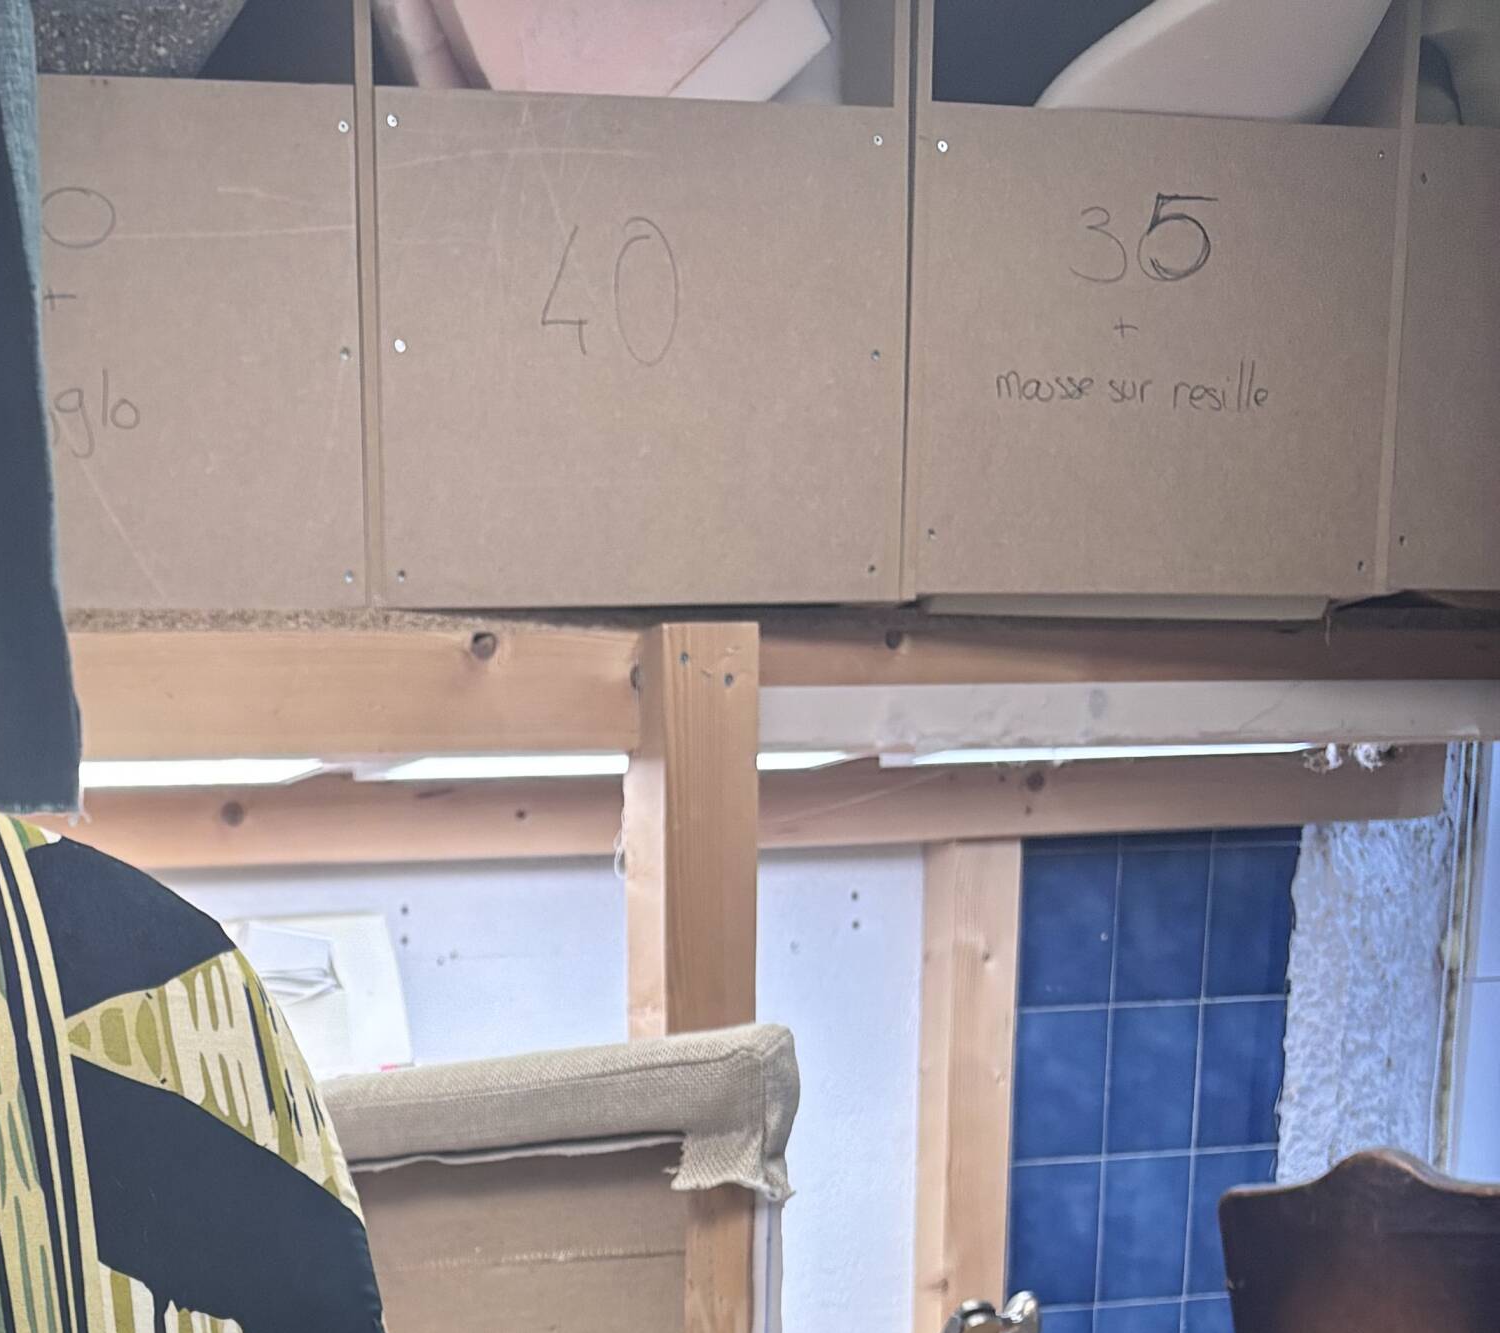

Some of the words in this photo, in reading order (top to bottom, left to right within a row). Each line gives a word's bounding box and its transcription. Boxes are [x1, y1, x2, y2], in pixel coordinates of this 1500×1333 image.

[1069, 192, 1218, 284] 35
[541, 216, 679, 367] 40
[1109, 379, 1152, 404] sur
